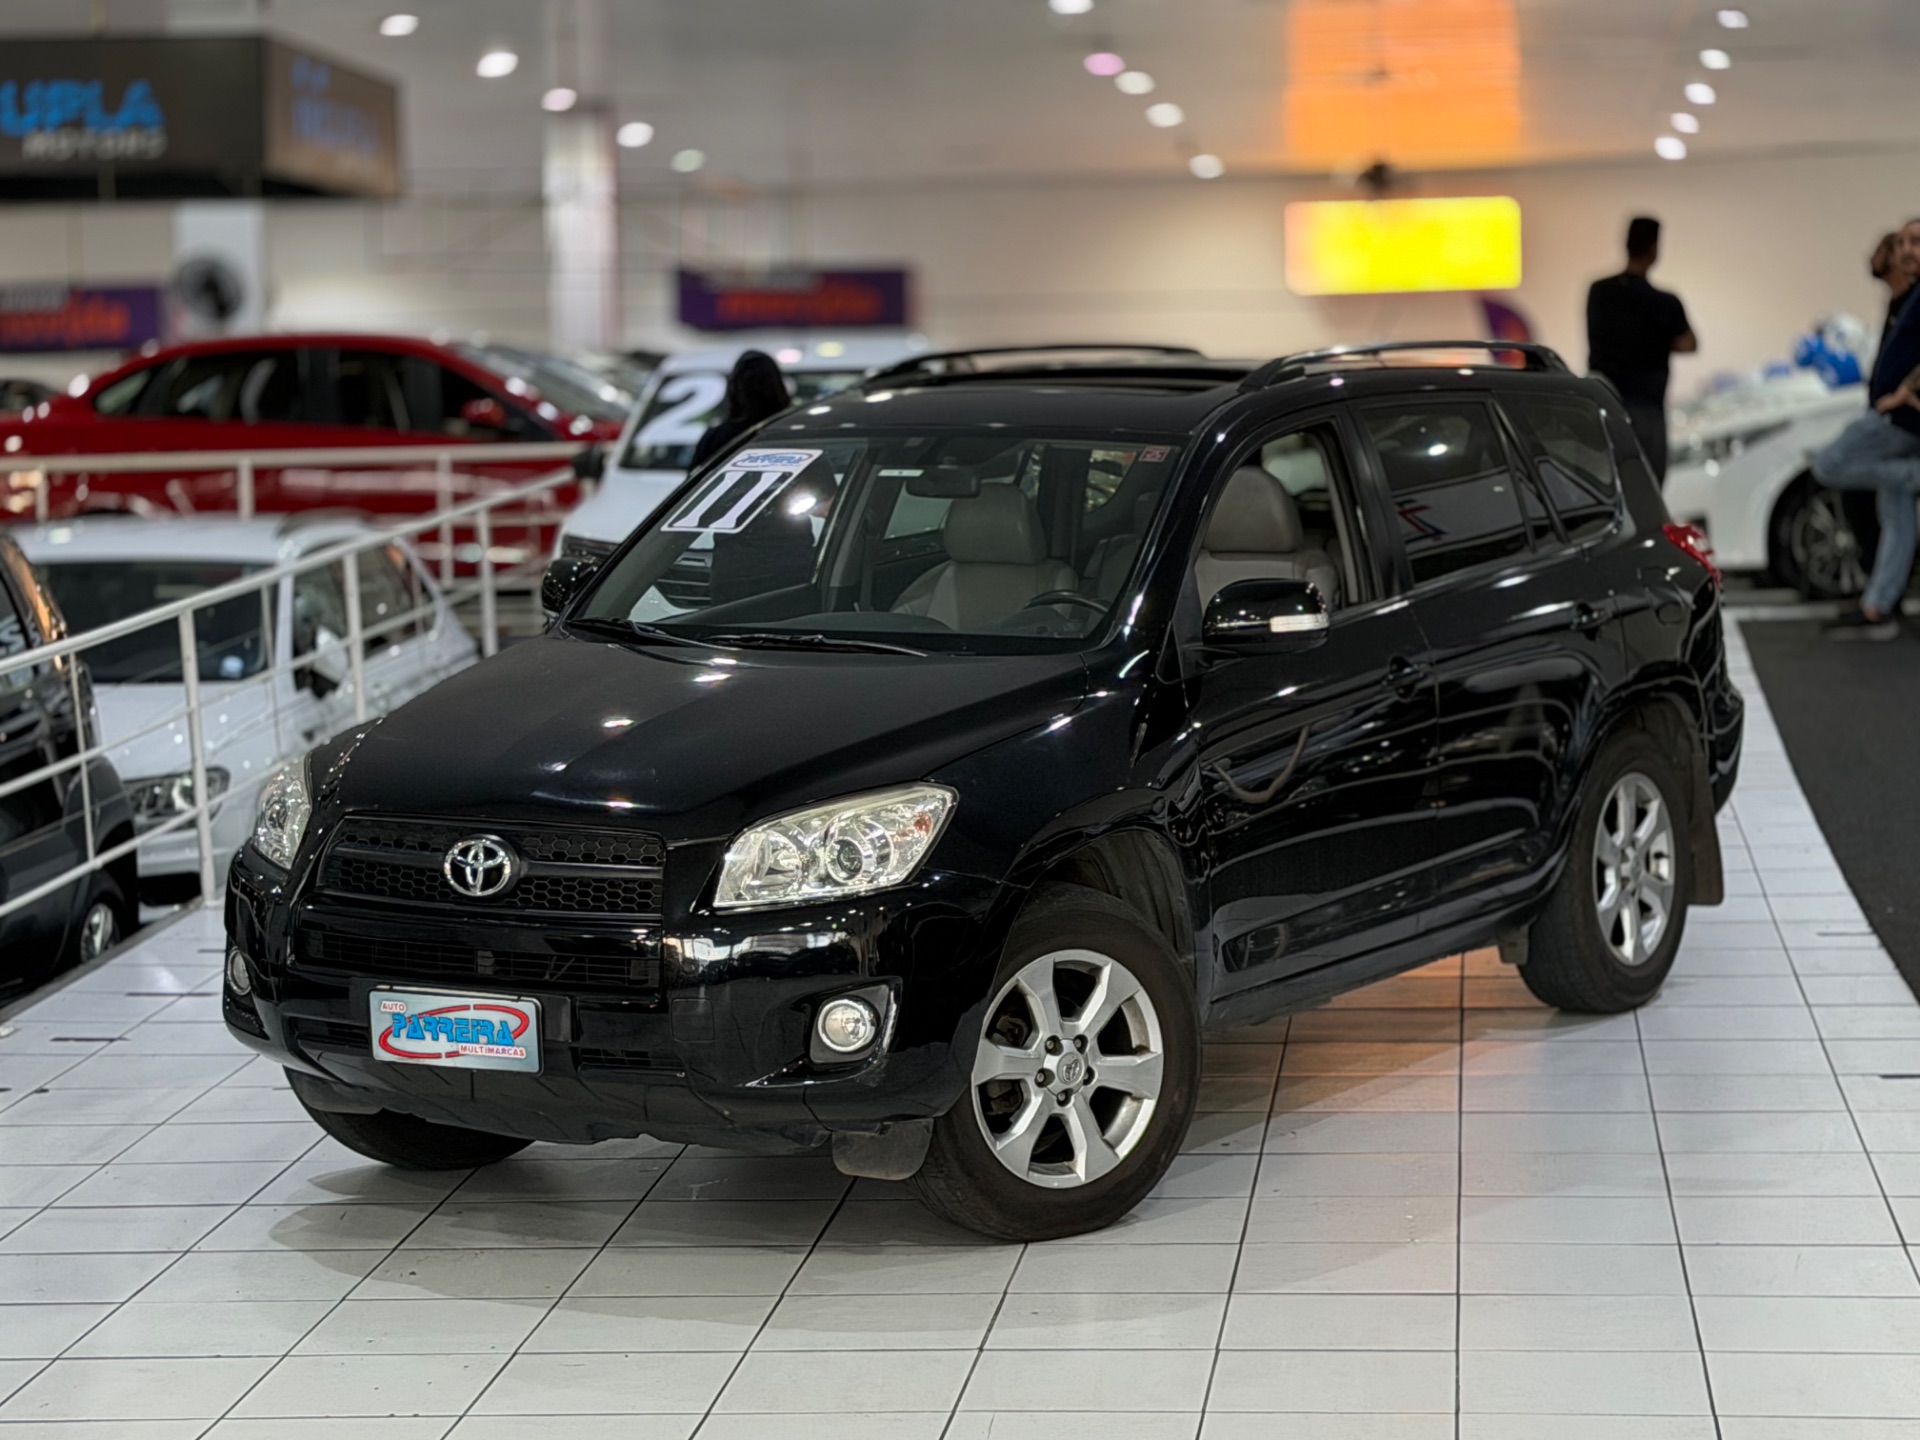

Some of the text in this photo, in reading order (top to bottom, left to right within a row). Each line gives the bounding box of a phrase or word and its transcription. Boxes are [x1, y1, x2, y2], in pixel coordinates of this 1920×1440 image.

[672, 471, 783, 528] 11
[382, 1001, 405, 1011] AUTO
[391, 1013, 515, 1046] PARREIRA
[460, 1045, 526, 1057] MULTIMARCAS
